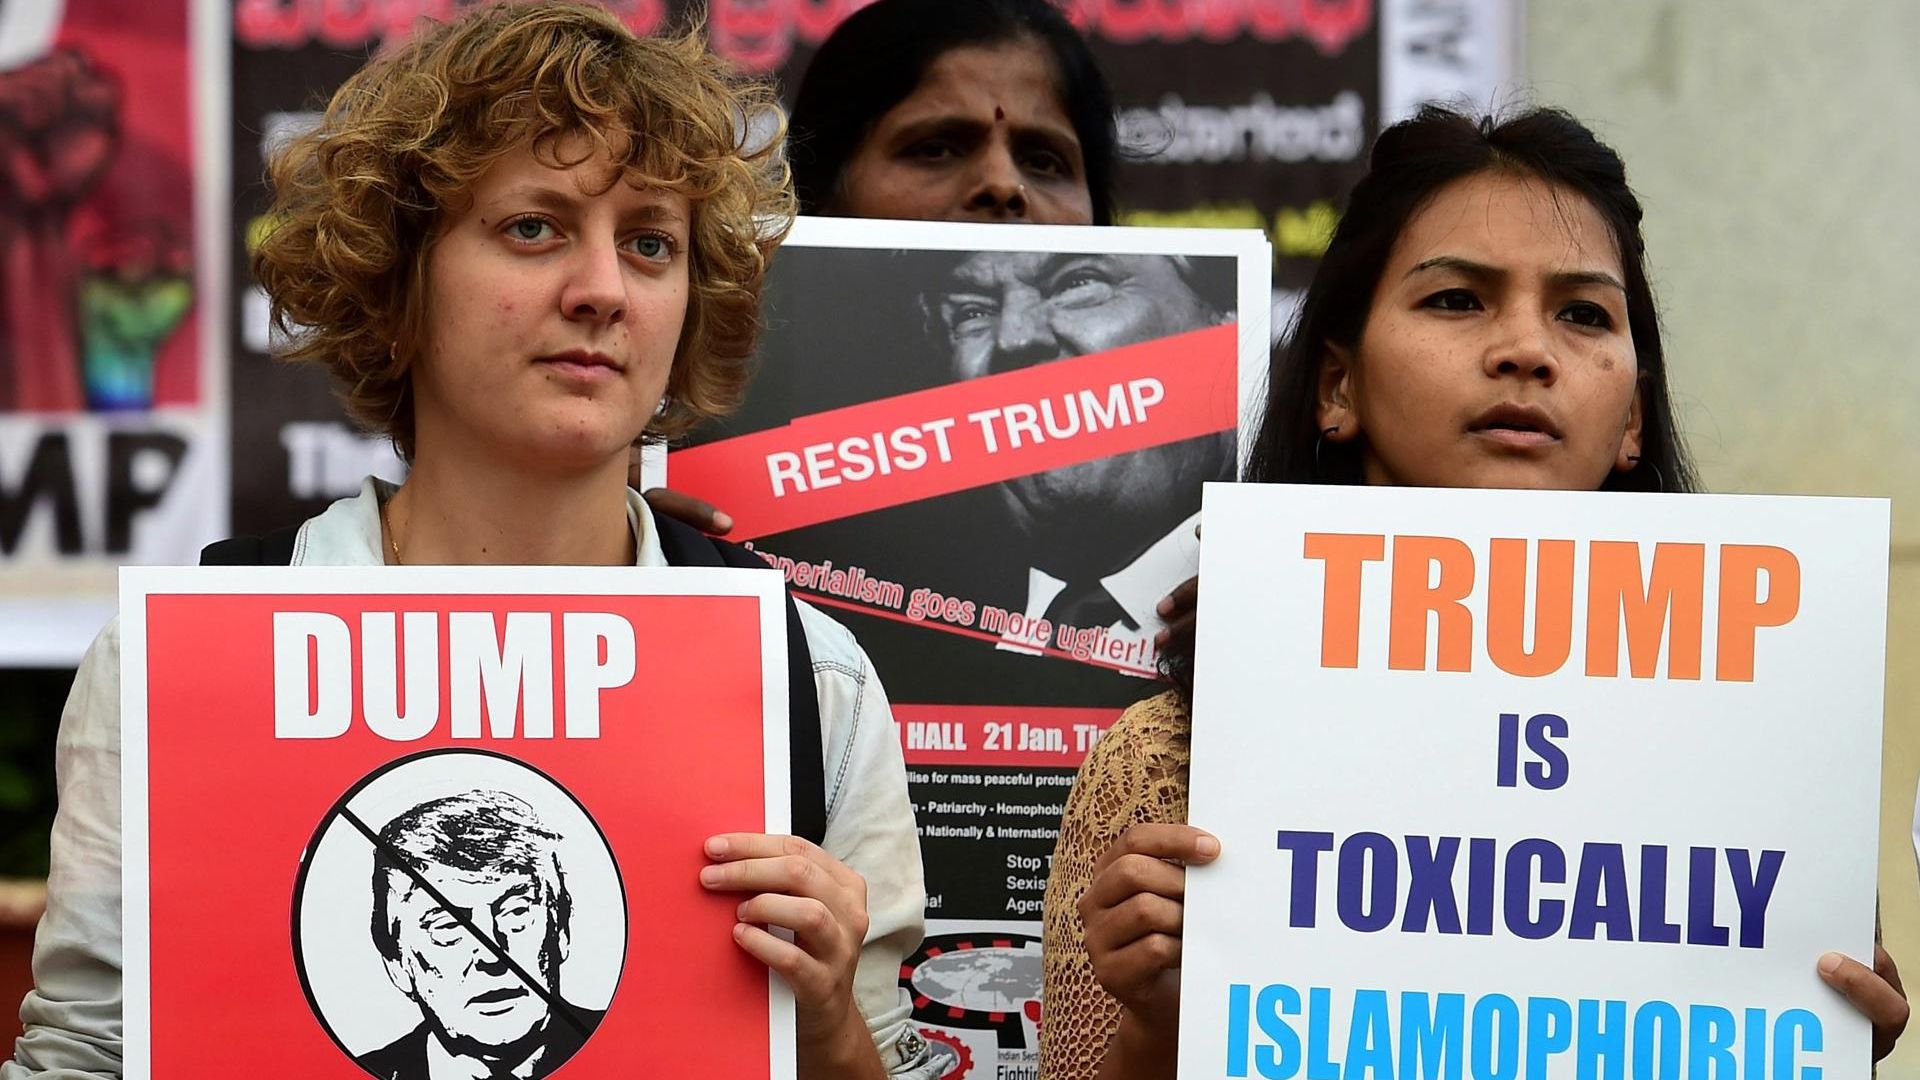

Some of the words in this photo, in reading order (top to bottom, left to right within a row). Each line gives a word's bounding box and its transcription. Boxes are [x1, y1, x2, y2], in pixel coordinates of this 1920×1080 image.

[765, 418, 955, 498] RESIST
[967, 377, 1165, 454] TRUMP
[745, 541, 904, 609] perialism
[906, 588, 976, 626] goes
[980, 604, 1052, 641] more
[1304, 532, 1801, 682] TRUMP
[272, 611, 637, 741] DUMP
[907, 722, 967, 750] HALL
[983, 722, 1012, 750] 21
[1017, 723, 1068, 754] Jan,
[1496, 713, 1570, 790] IS
[928, 801, 986, 816] Patriarchy
[932, 772, 948, 783] for
[951, 774, 981, 784] mass
[984, 774, 1033, 787] peaceful
[926, 825, 983, 840] Nationally
[986, 826, 995, 838] &
[1006, 854, 1041, 872] Stop
[1276, 830, 1787, 949] TOXICALLY
[998, 1050, 1020, 1061] Indian
[1226, 983, 1824, 1080] ISLAMOPHOBIC
